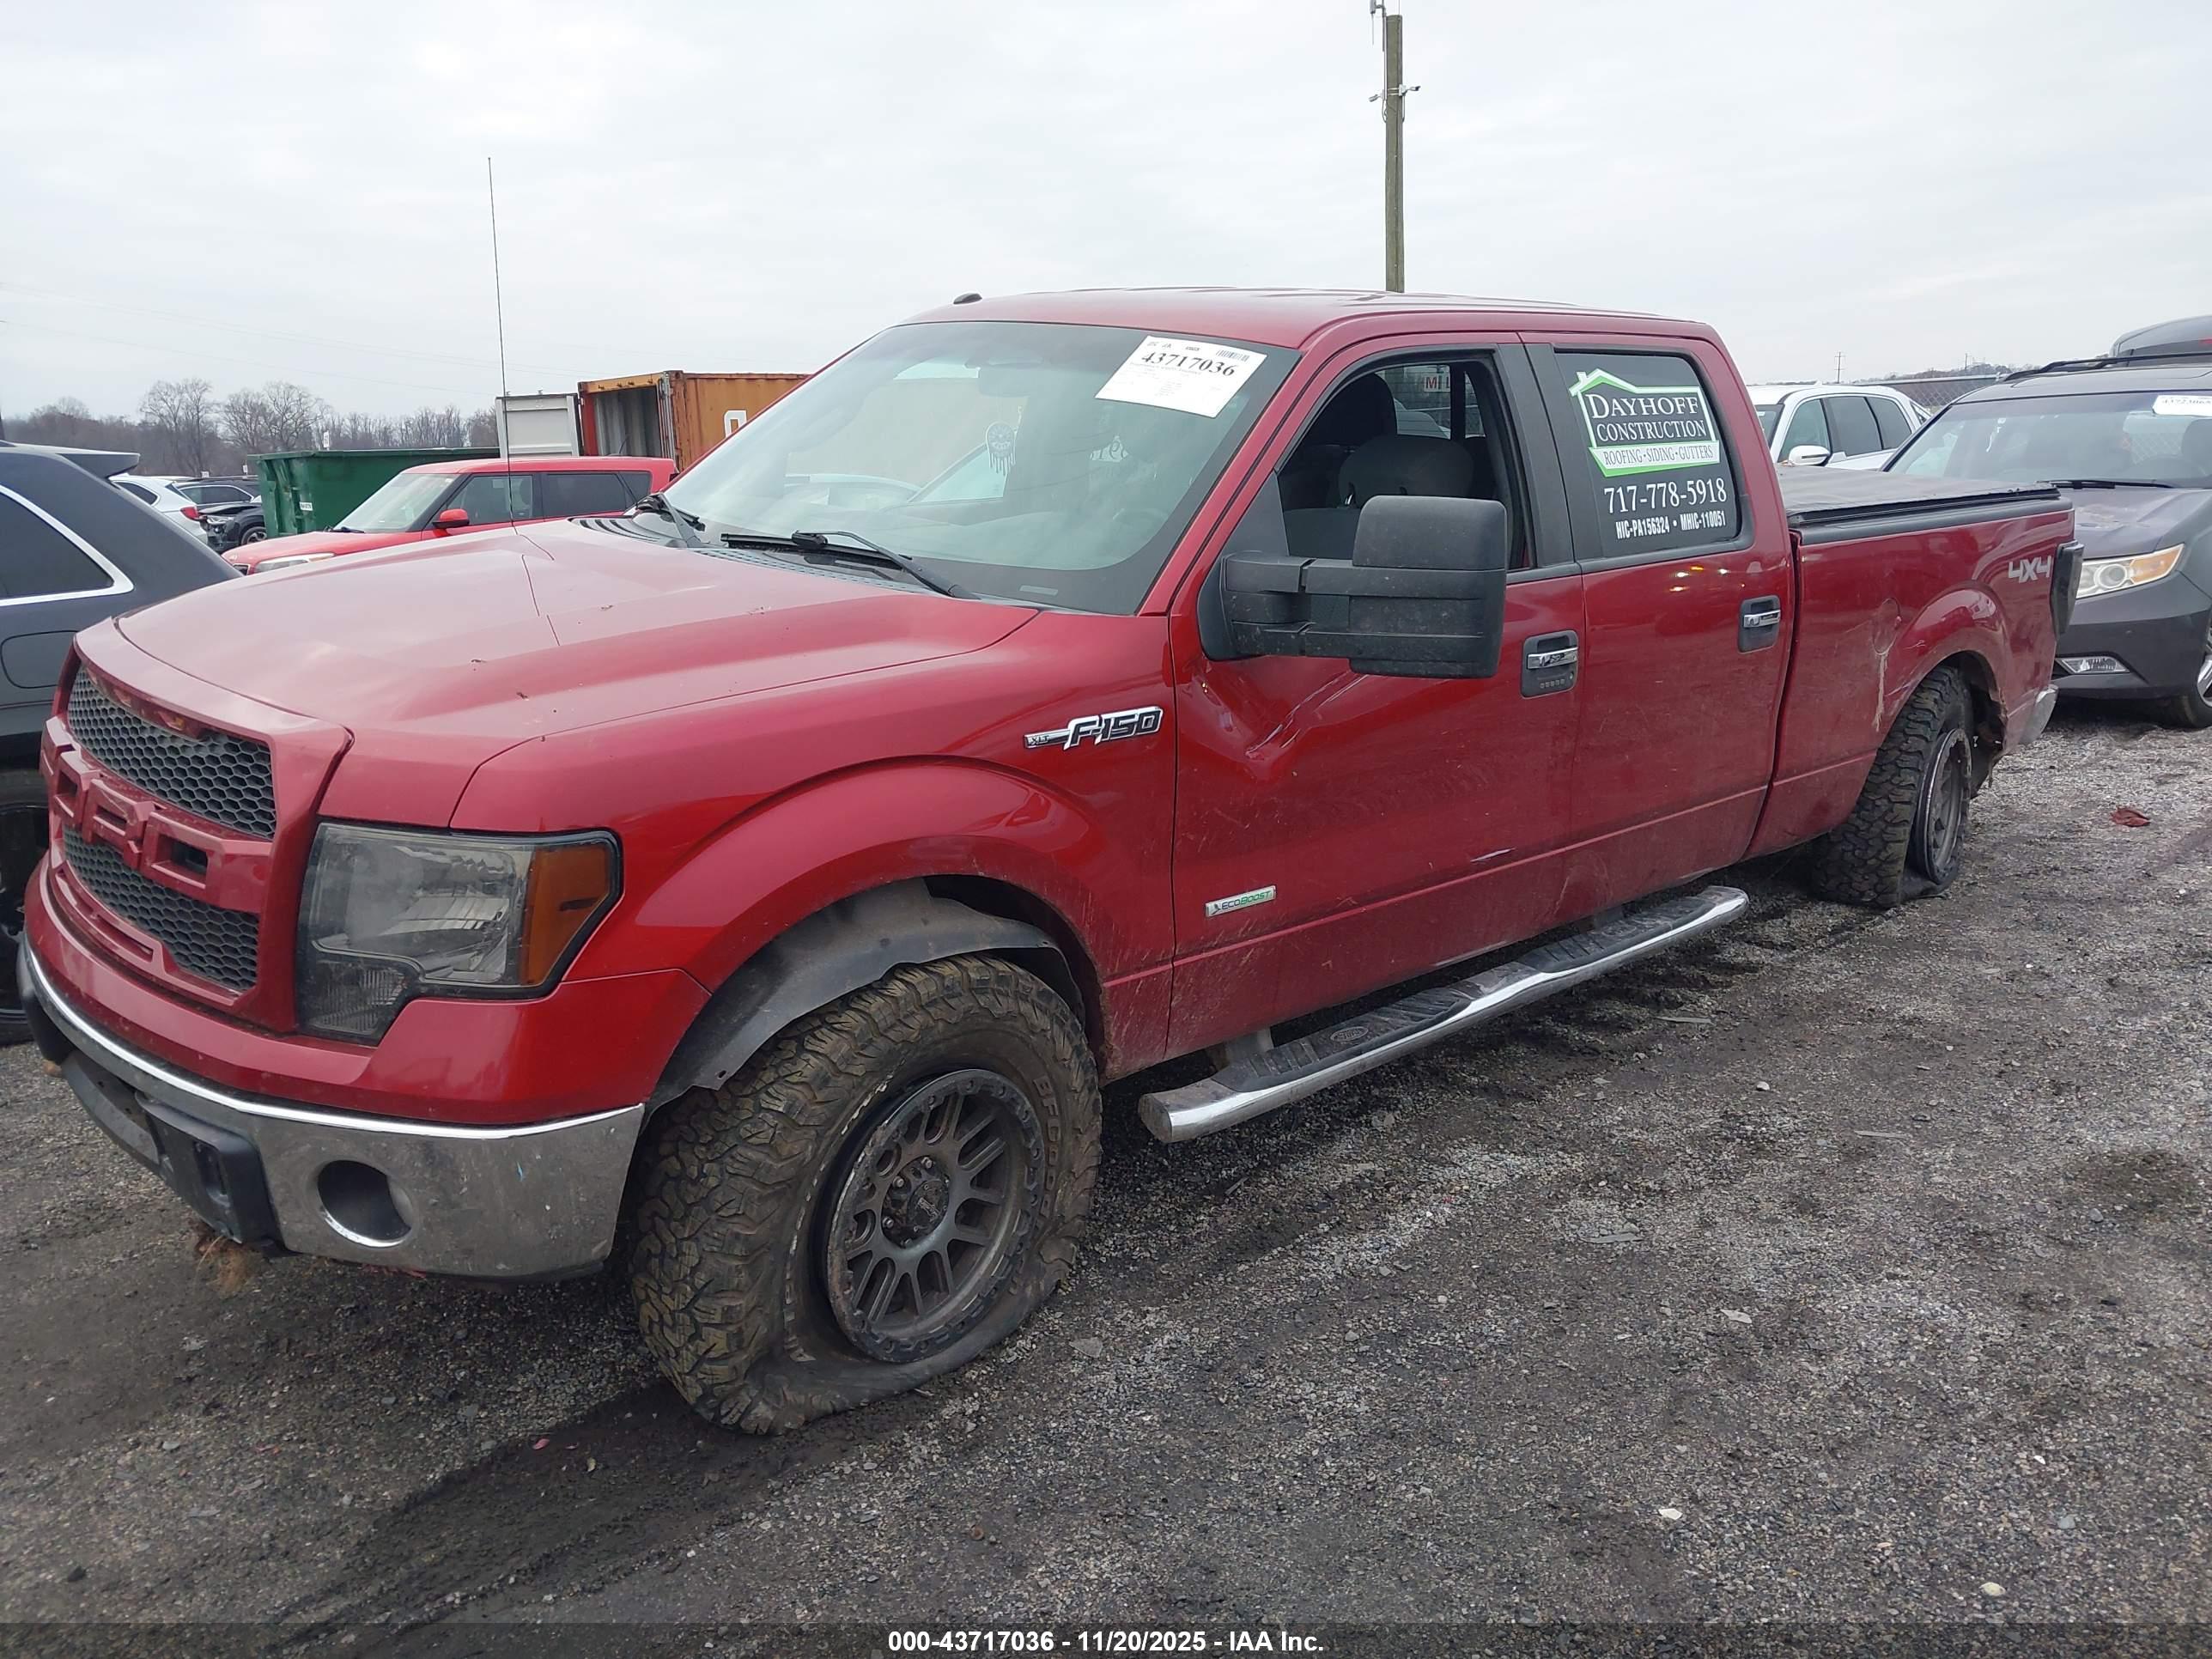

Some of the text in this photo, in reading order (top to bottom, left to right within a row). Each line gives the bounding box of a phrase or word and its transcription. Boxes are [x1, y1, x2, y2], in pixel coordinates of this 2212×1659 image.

[1141, 351, 1239, 376] 43717036
[1585, 394, 1699, 419] DAYHOFF
[1596, 420, 1707, 441] CONSTRUCTION
[1604, 477, 1727, 514] 717-778-5918
[1615, 515, 1670, 540] HIC-PA156324
[1030, 734, 1049, 746] XLT
